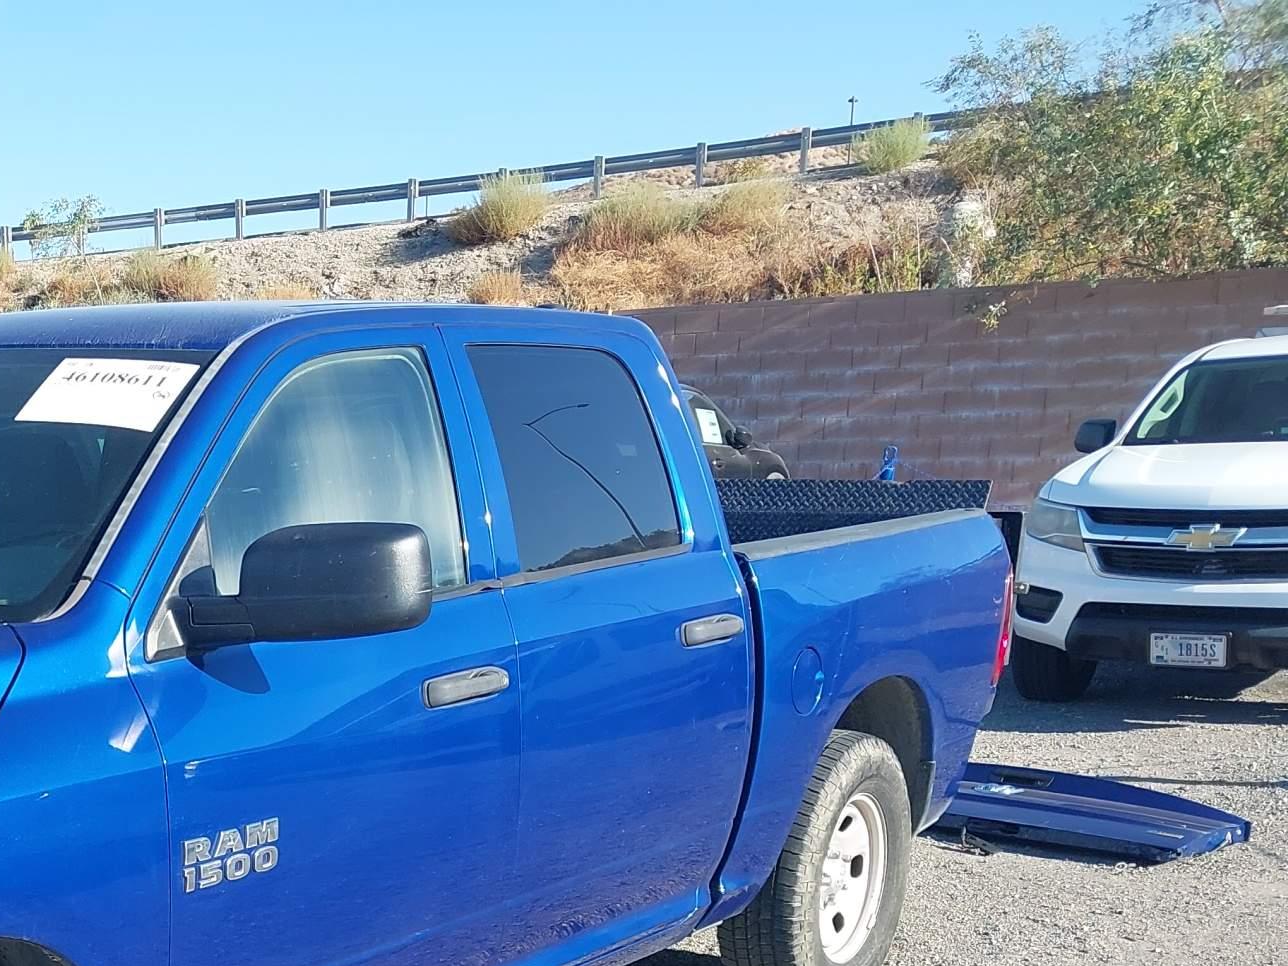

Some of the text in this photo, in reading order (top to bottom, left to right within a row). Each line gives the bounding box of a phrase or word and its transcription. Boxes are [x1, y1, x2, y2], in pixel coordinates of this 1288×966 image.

[62, 371, 167, 387] 46108611
[1178, 642, 1217, 657] 1815S
[183, 817, 279, 866] RAM
[183, 845, 279, 893] 1500
